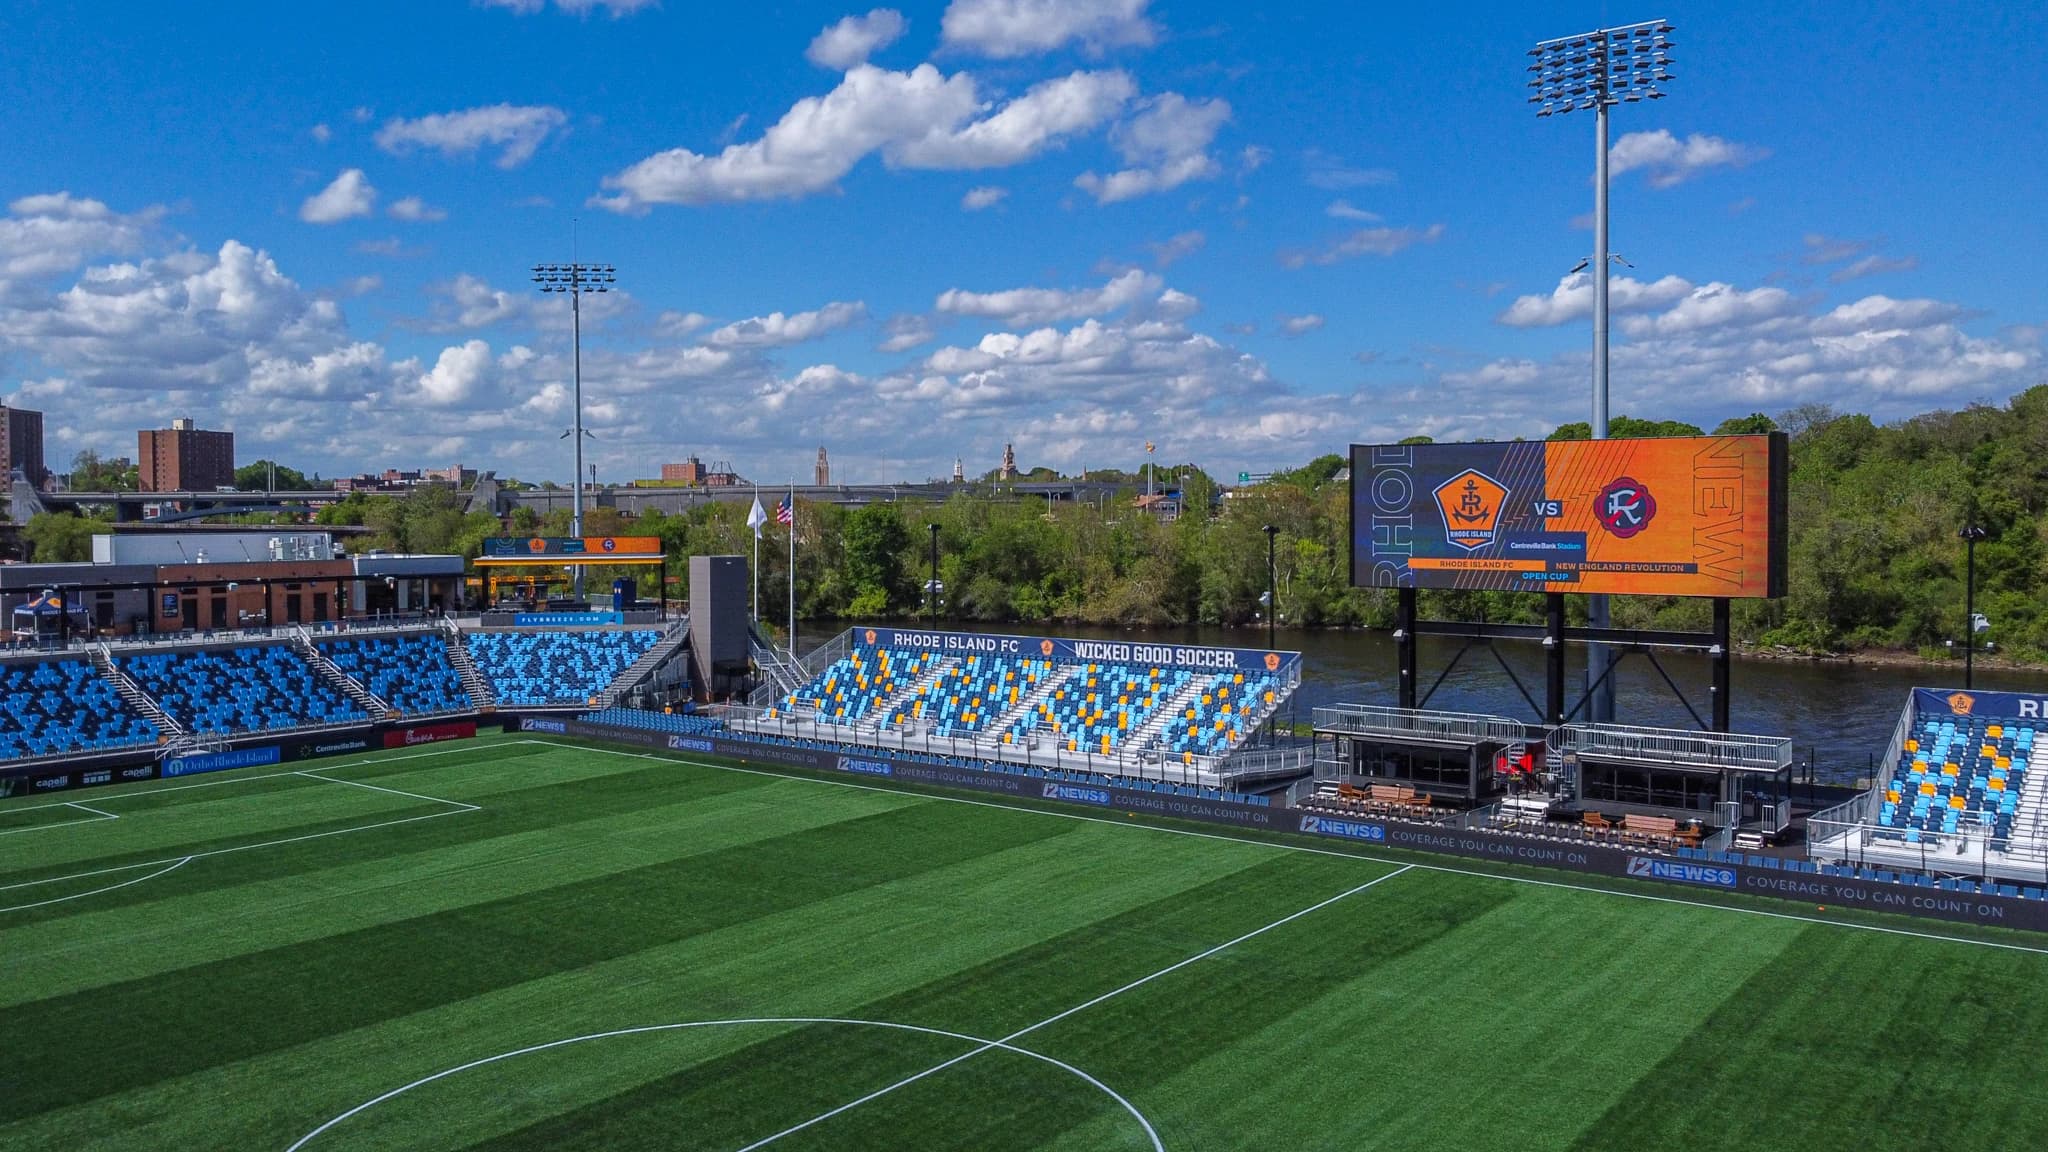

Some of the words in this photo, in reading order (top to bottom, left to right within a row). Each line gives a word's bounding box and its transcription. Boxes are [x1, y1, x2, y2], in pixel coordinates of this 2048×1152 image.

[1534, 502, 1559, 516] VS
[1557, 542, 1581, 550] Stadium
[1440, 560, 1468, 568] RHODE
[1470, 561, 1500, 569] ISLAND
[1503, 561, 1514, 569] FC
[1555, 562, 1576, 570] NEW
[1579, 562, 1622, 572] ENGLAND
[1624, 563, 1685, 573] REVOLUTION
[1522, 572, 1547, 580] OPEN
[1549, 572, 1569, 580] CUP
[894, 633, 940, 648] RHODE
[944, 636, 996, 651] ISLAND
[1001, 639, 1018, 653] FC
[1075, 642, 1130, 661] WICKED
[1134, 646, 1172, 664] GOOD
[1176, 649, 1238, 669] SOCCER.
[668, 735, 679, 748] 12
[679, 738, 705, 751] NEWS
[837, 757, 850, 770] 12
[850, 758, 882, 773] NEWS
[938, 771, 954, 782] YOU
[956, 774, 973, 785] CAN
[1006, 779, 1019, 790] ON
[1043, 783, 1059, 799] 12
[1060, 785, 1099, 802] NEWS
[1115, 794, 1165, 810] COVERAGE
[1168, 802, 1188, 813] YOU
[1191, 805, 1212, 816] CAN
[1214, 807, 1249, 821] COUNT
[1253, 812, 1269, 824] ON
[1300, 815, 1320, 833] 12
[1320, 818, 1368, 838] NEWS
[1392, 830, 1456, 848] COVERAGE
[1459, 839, 1484, 851] YOU
[1488, 842, 1515, 856] CAN
[1518, 847, 1564, 861] COUNT
[1567, 852, 1588, 864] ON
[1626, 856, 1652, 877] 12
[1653, 862, 1718, 882] NEWS
[1746, 875, 1829, 896] COVERAGE
[1835, 886, 1867, 900] YOU
[1872, 891, 1906, 905] CAN
[1912, 896, 1972, 913] COUNT
[1977, 903, 2004, 918] ON
